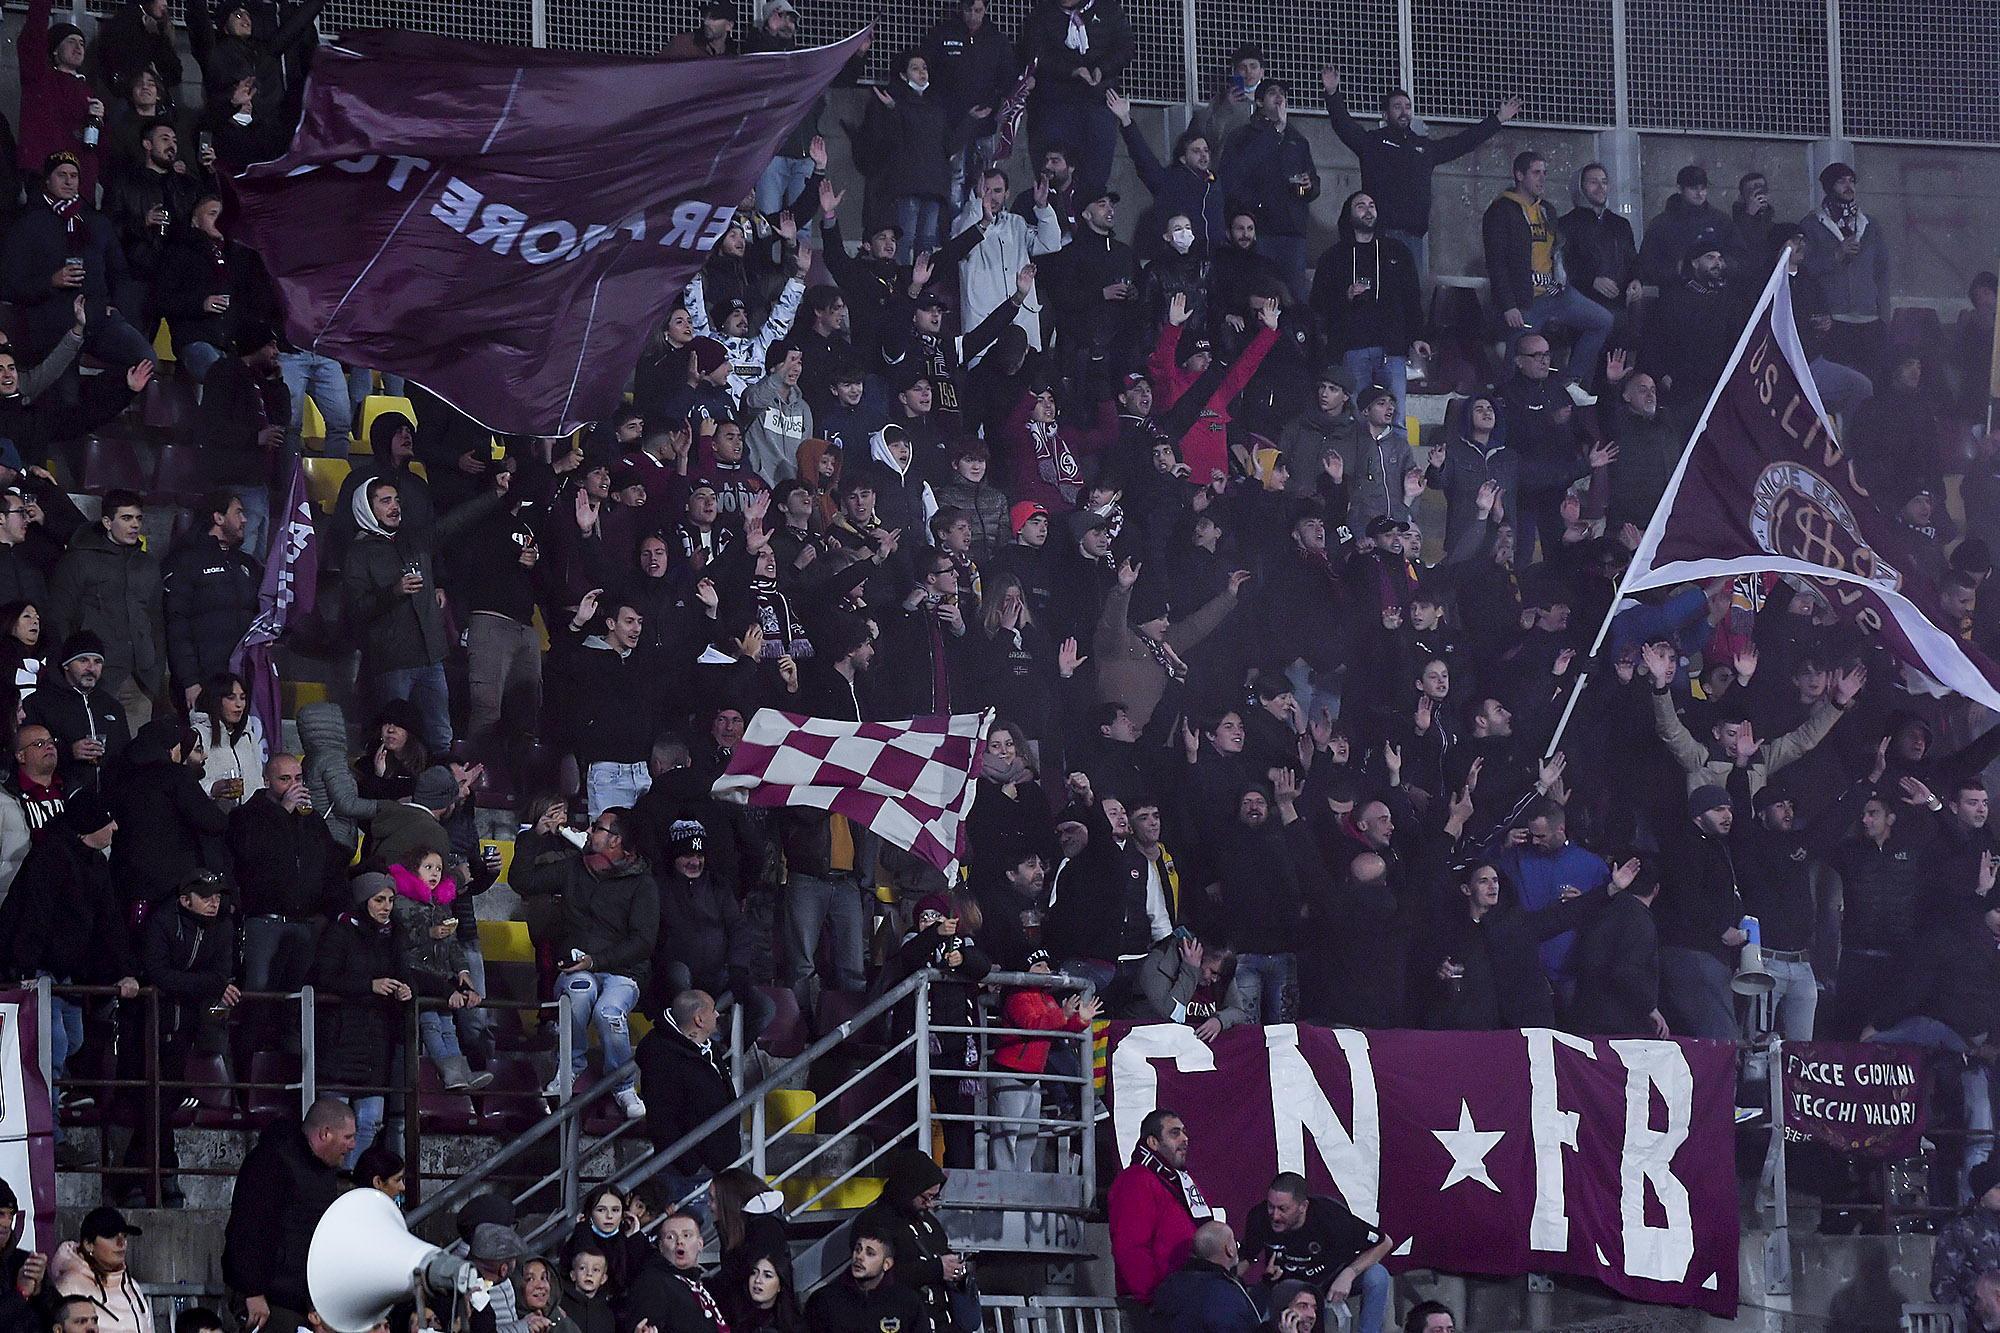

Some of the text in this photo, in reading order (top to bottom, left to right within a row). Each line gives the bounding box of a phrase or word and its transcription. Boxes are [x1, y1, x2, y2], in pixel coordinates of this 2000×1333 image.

[1787, 1054, 1916, 1087] FACCE GIOVANI
[1791, 1091, 1916, 1126] VECCHI VALORI
